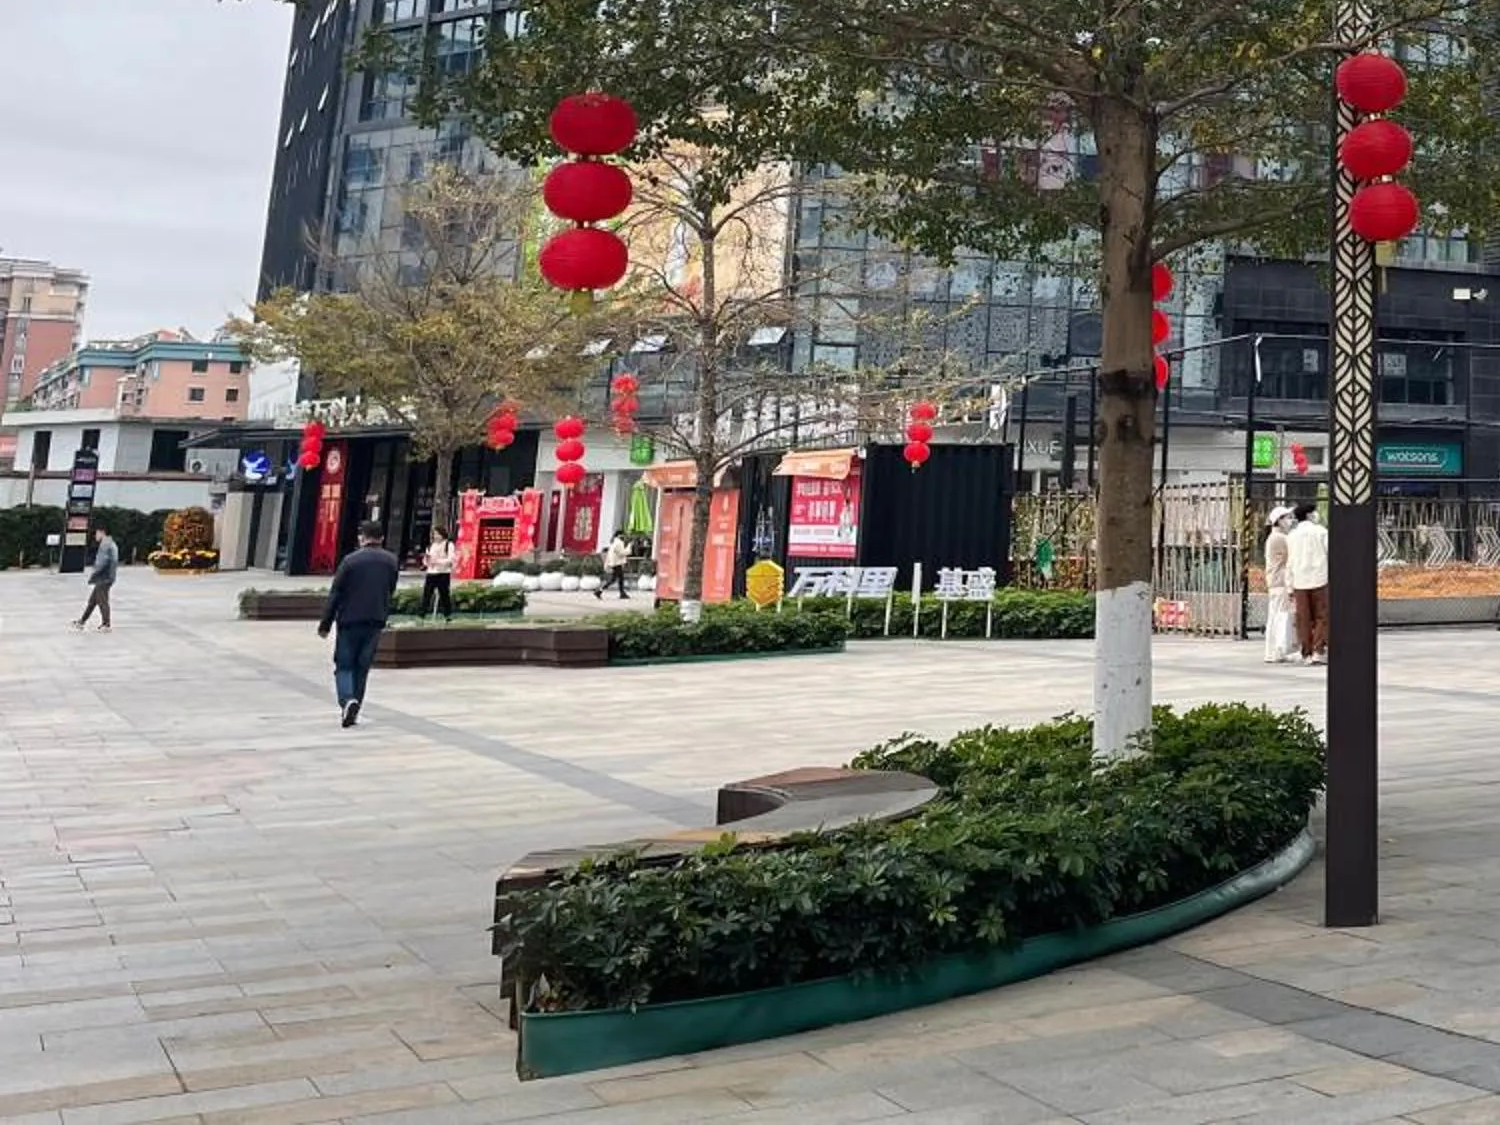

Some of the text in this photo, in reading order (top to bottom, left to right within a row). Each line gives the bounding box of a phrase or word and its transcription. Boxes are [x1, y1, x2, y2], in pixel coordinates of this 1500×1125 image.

[1386, 450, 1439, 463] watsons
[788, 566, 899, 598] 万科里
